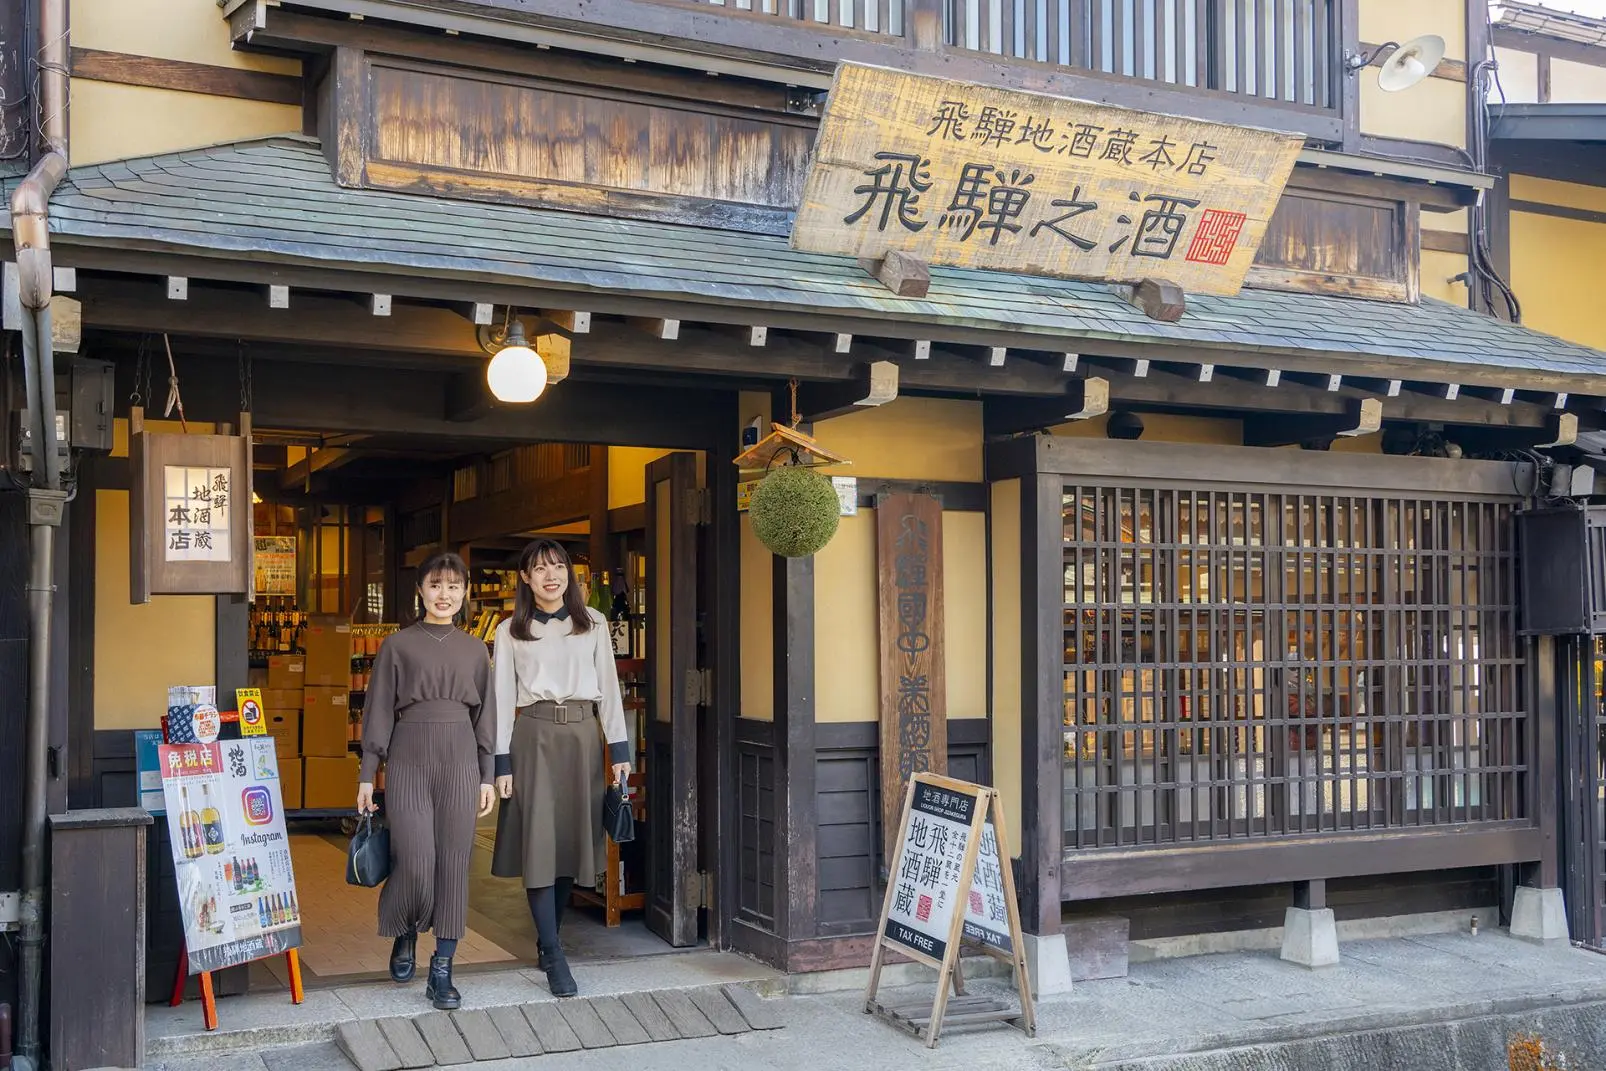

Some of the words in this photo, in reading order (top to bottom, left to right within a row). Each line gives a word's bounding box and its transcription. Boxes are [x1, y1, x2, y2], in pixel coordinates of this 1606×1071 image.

[927, 101, 1218, 177] 飛騨地酒蔵本店
[844, 151, 1201, 260] 飛騨之酒
[168, 504, 192, 550] 本店
[192, 484, 213, 551] 地酒蔵
[168, 749, 213, 768] 免税店
[228, 744, 247, 778] 地酒
[933, 806, 945, 814] SHOP
[241, 832, 283, 847] Instagram
[919, 822, 949, 889] 飛騨
[892, 816, 928, 917] 地酒蔵
[898, 926, 914, 945] TAX
[913, 932, 934, 952] FREE
